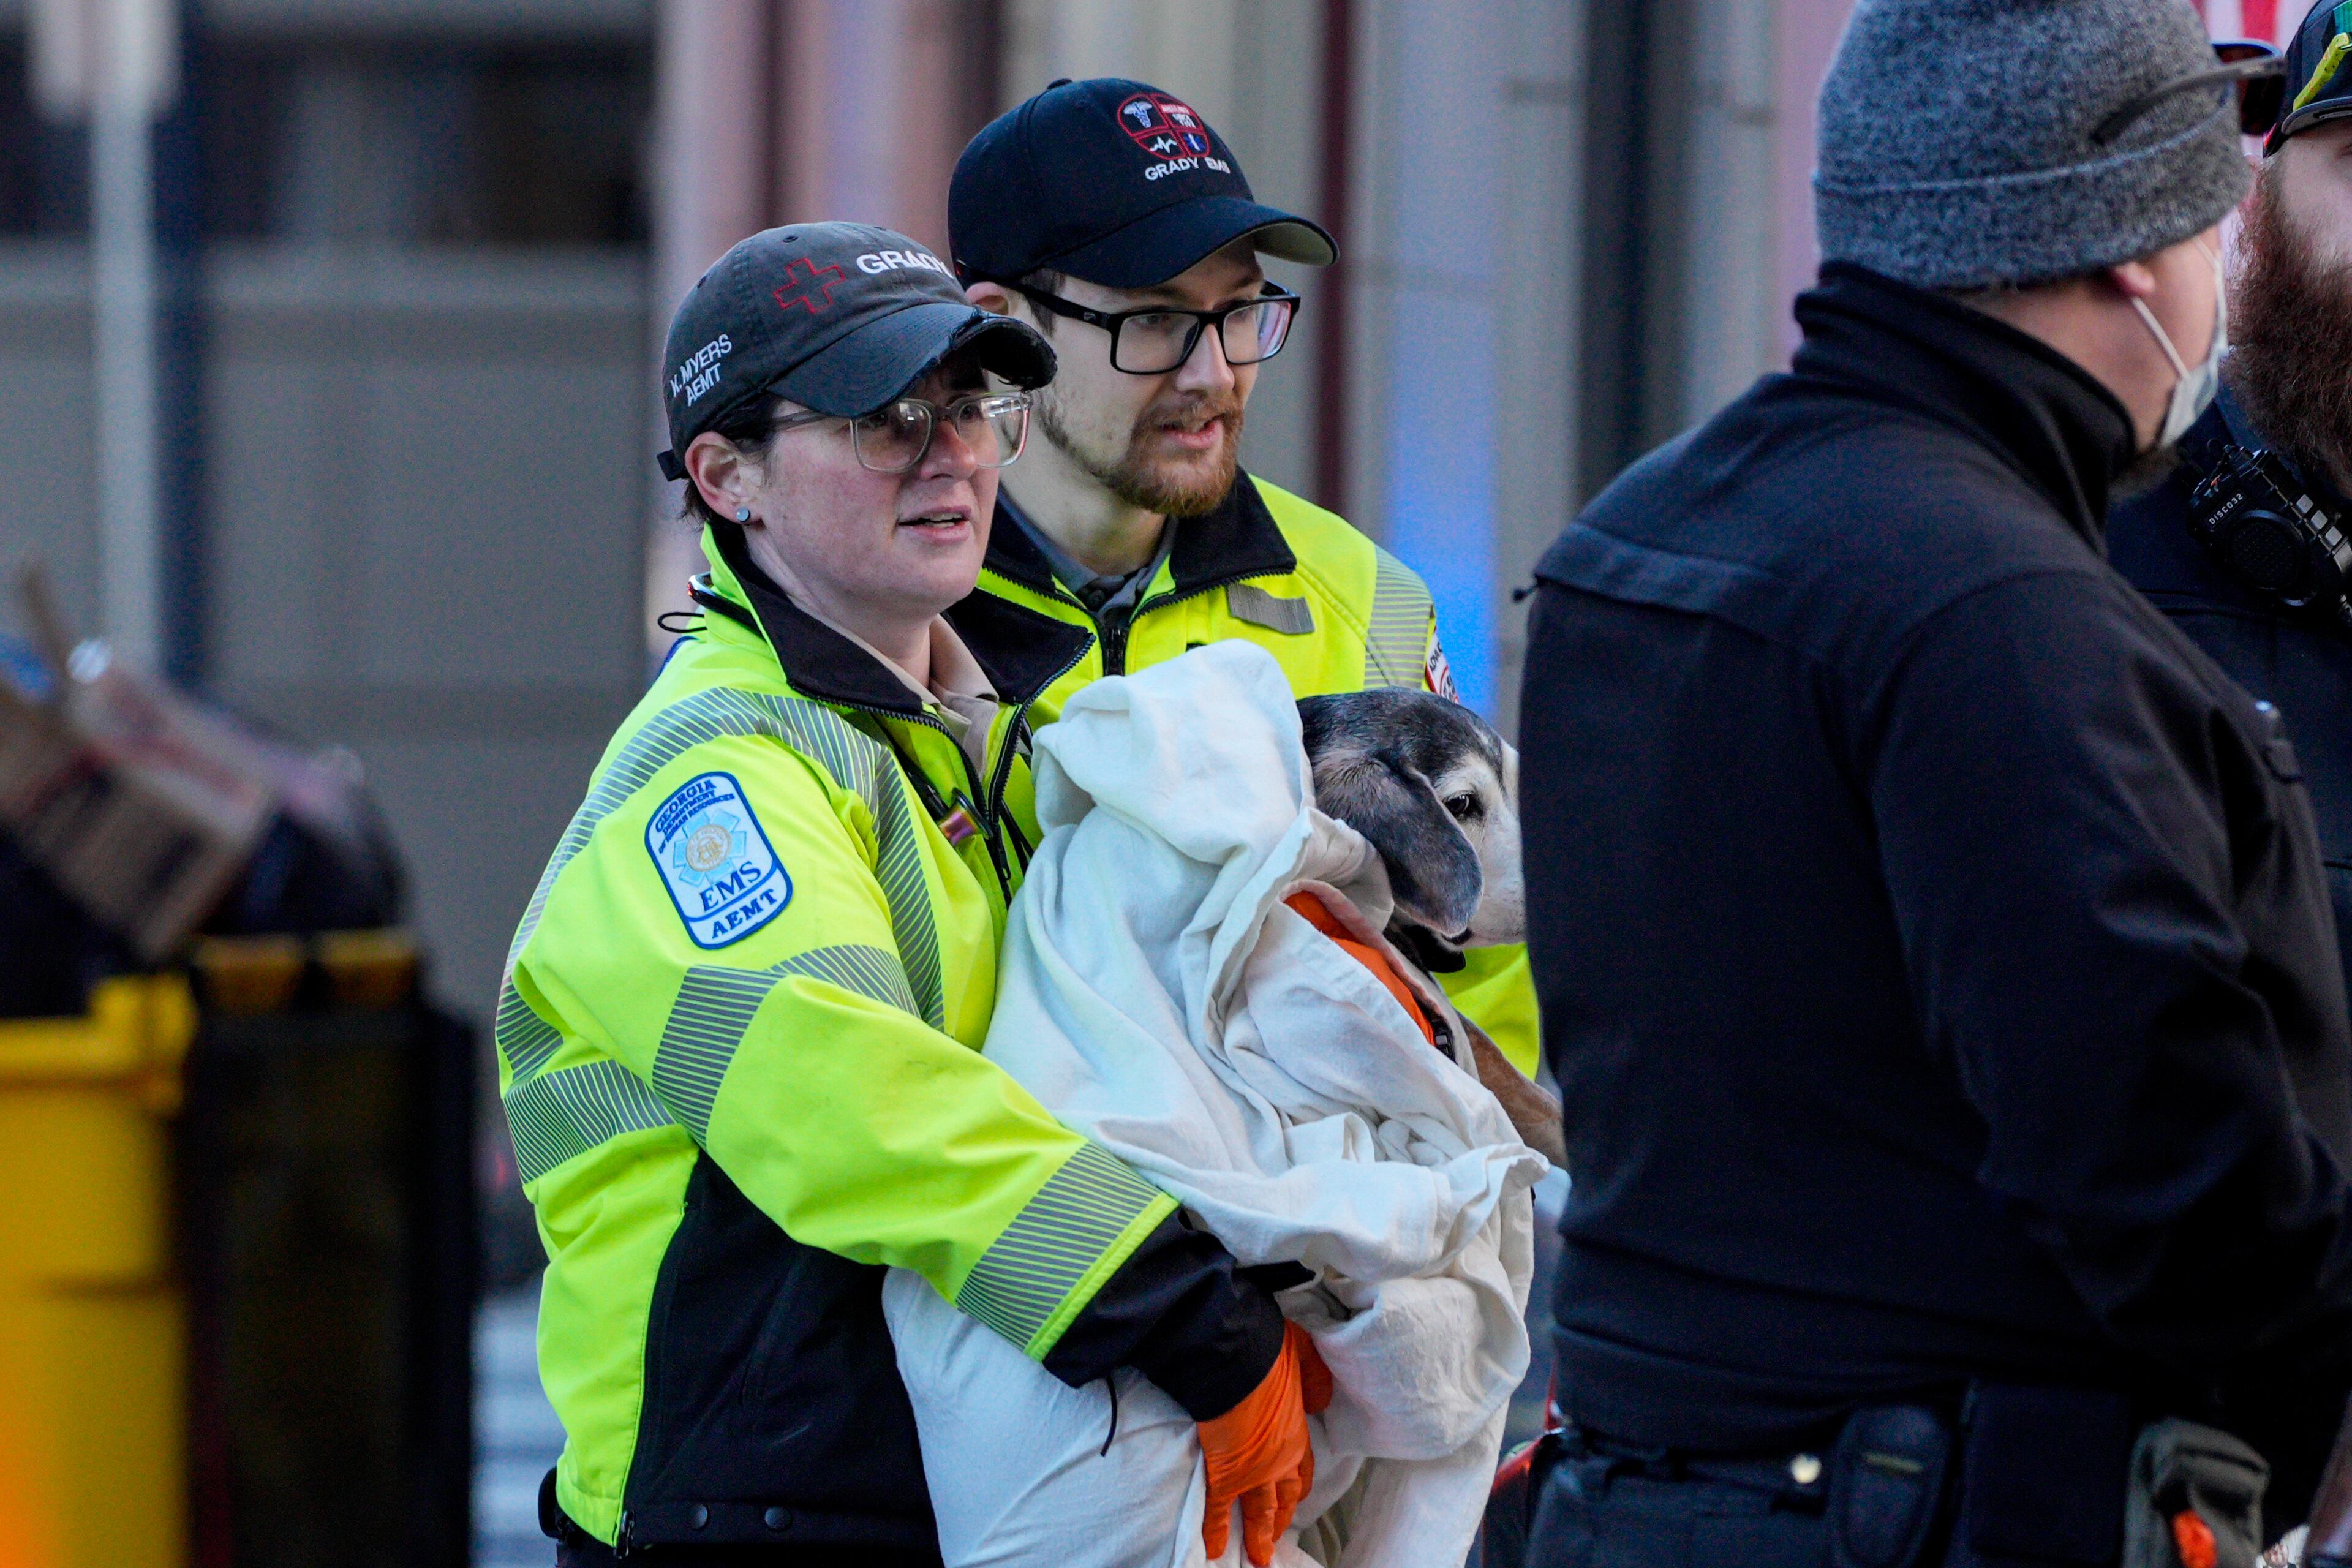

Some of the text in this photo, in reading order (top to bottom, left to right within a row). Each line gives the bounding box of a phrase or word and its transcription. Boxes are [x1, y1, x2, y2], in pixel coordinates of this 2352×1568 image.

[1145, 157, 1231, 181] GRADY EMS
[856, 250, 954, 279] GRADY
[680, 334, 732, 386] MYERS
[685, 362, 721, 407] AEMT
[655, 779, 717, 832] GEORGIA
[699, 861, 761, 912] EMS
[712, 888, 777, 939] AEMT
